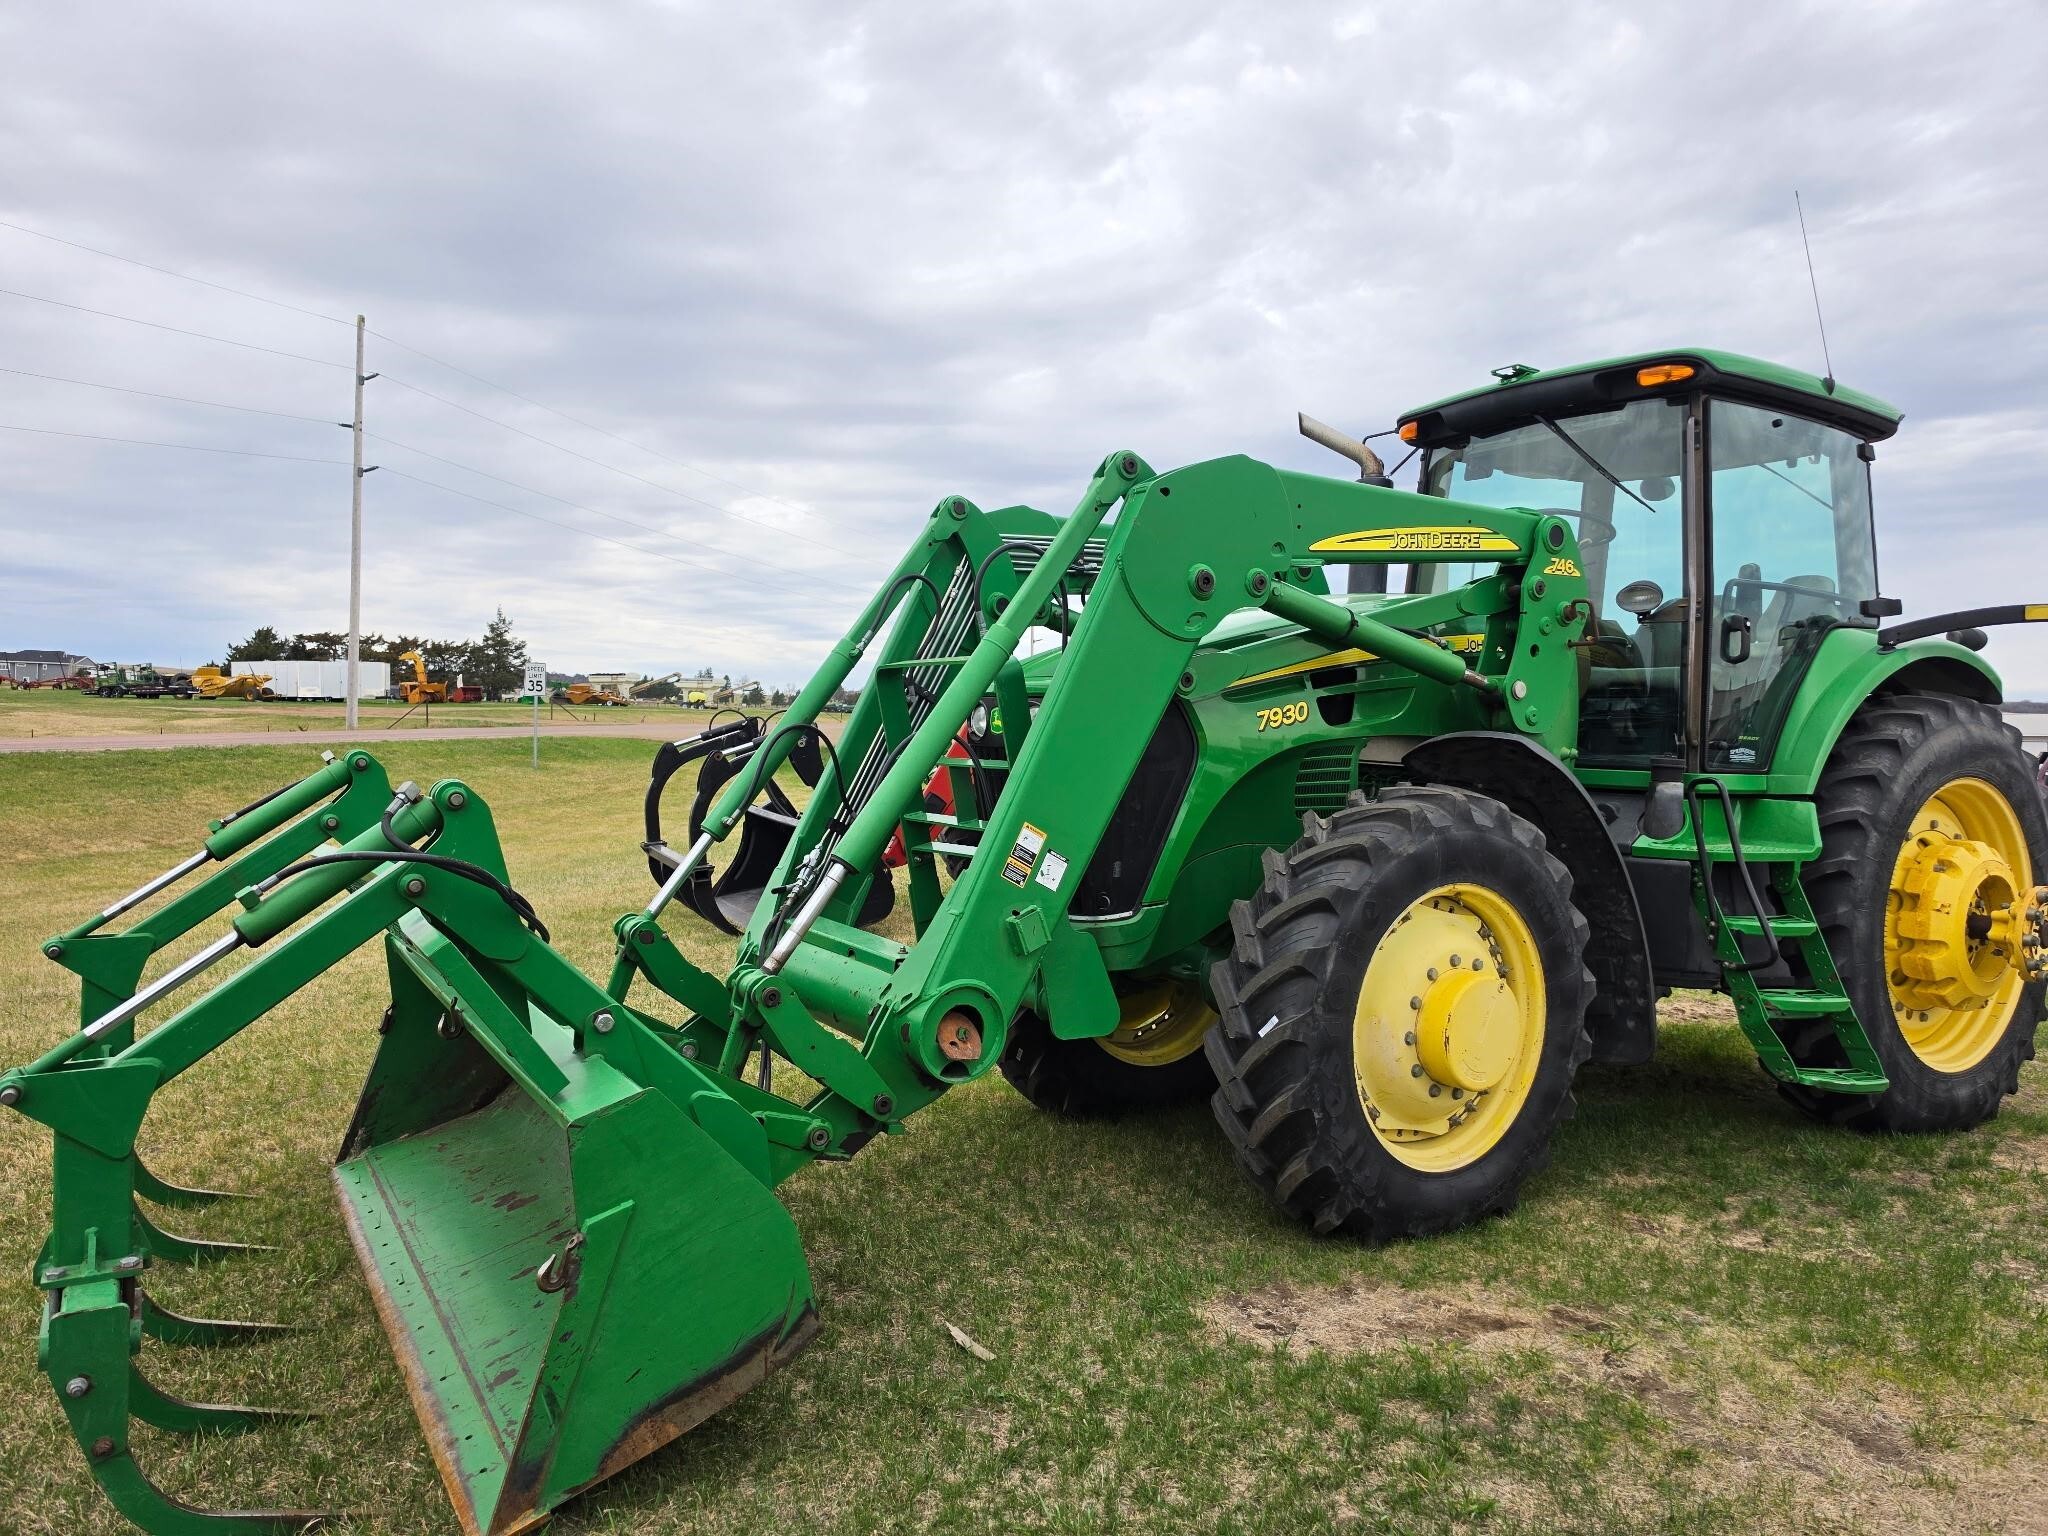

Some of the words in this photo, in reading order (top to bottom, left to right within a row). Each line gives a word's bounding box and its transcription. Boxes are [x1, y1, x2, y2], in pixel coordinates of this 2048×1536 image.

[1551, 557, 1574, 574] 746
[527, 680, 544, 692] 35
[1256, 700, 1309, 732] 7930
